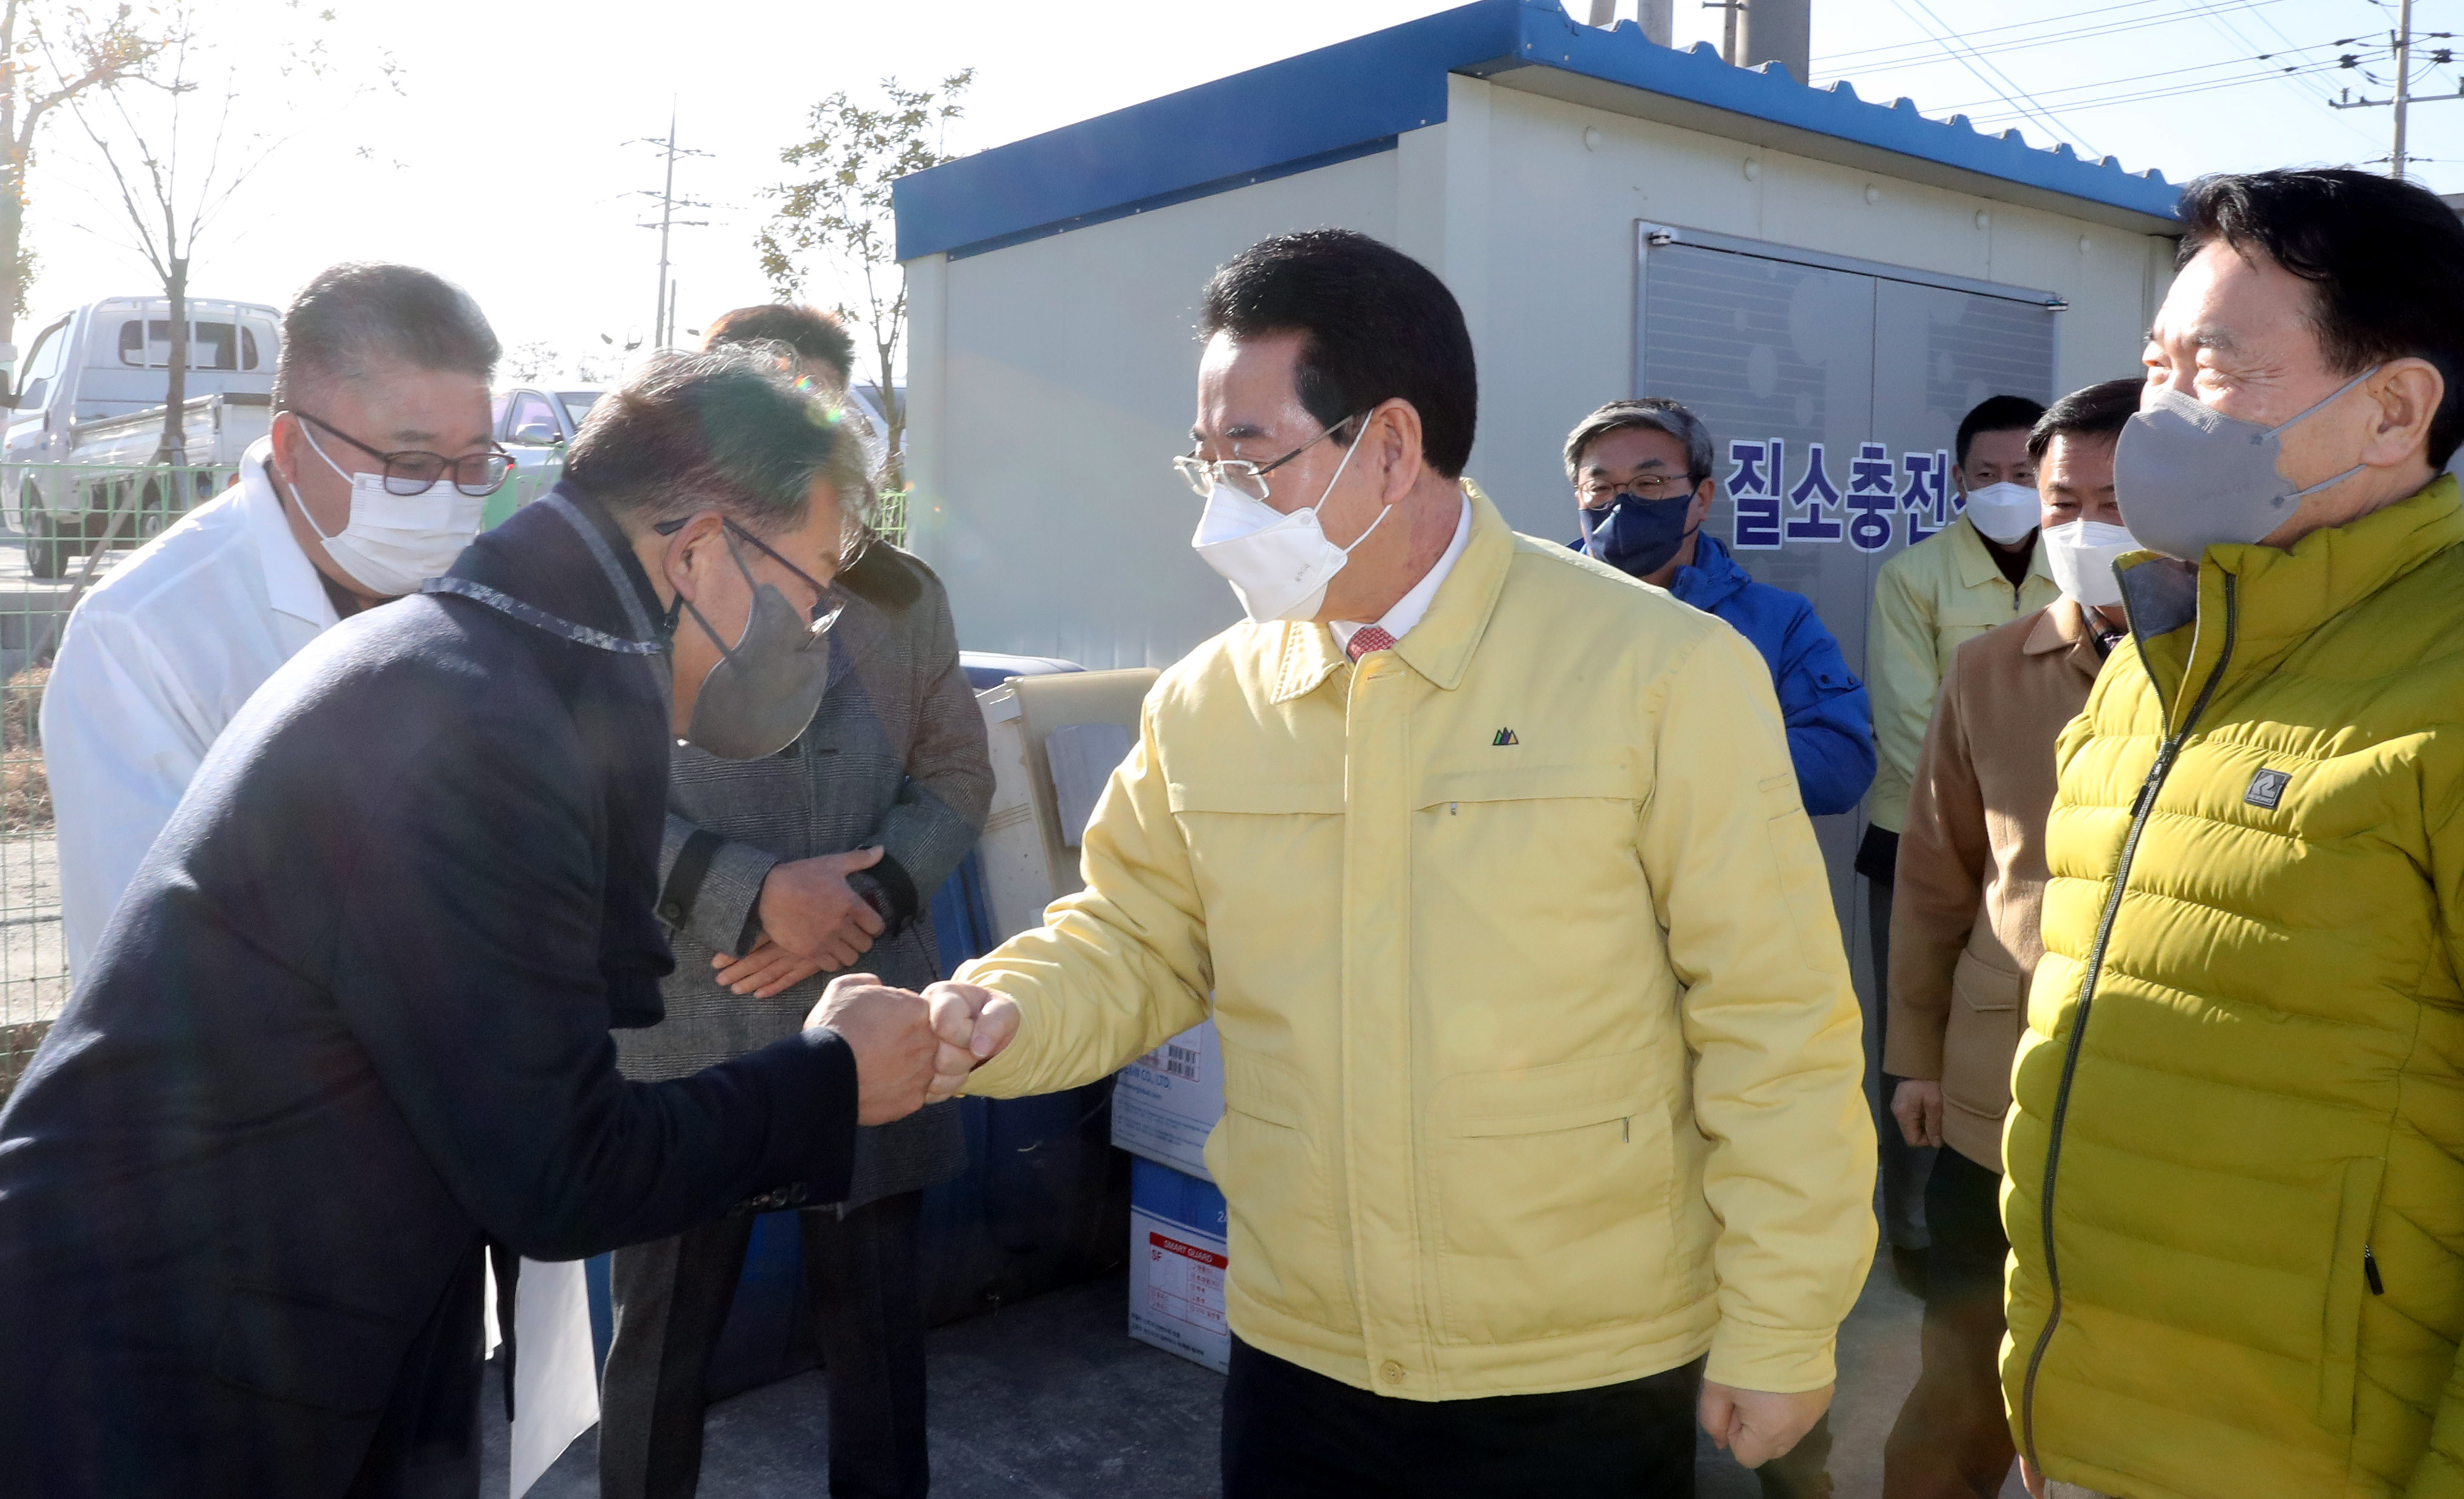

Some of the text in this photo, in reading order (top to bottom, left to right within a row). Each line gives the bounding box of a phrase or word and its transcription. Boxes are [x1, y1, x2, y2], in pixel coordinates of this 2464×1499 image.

[1724, 437, 1967, 553] 질소충전
[1163, 1239, 1213, 1263] SMART GUARD
